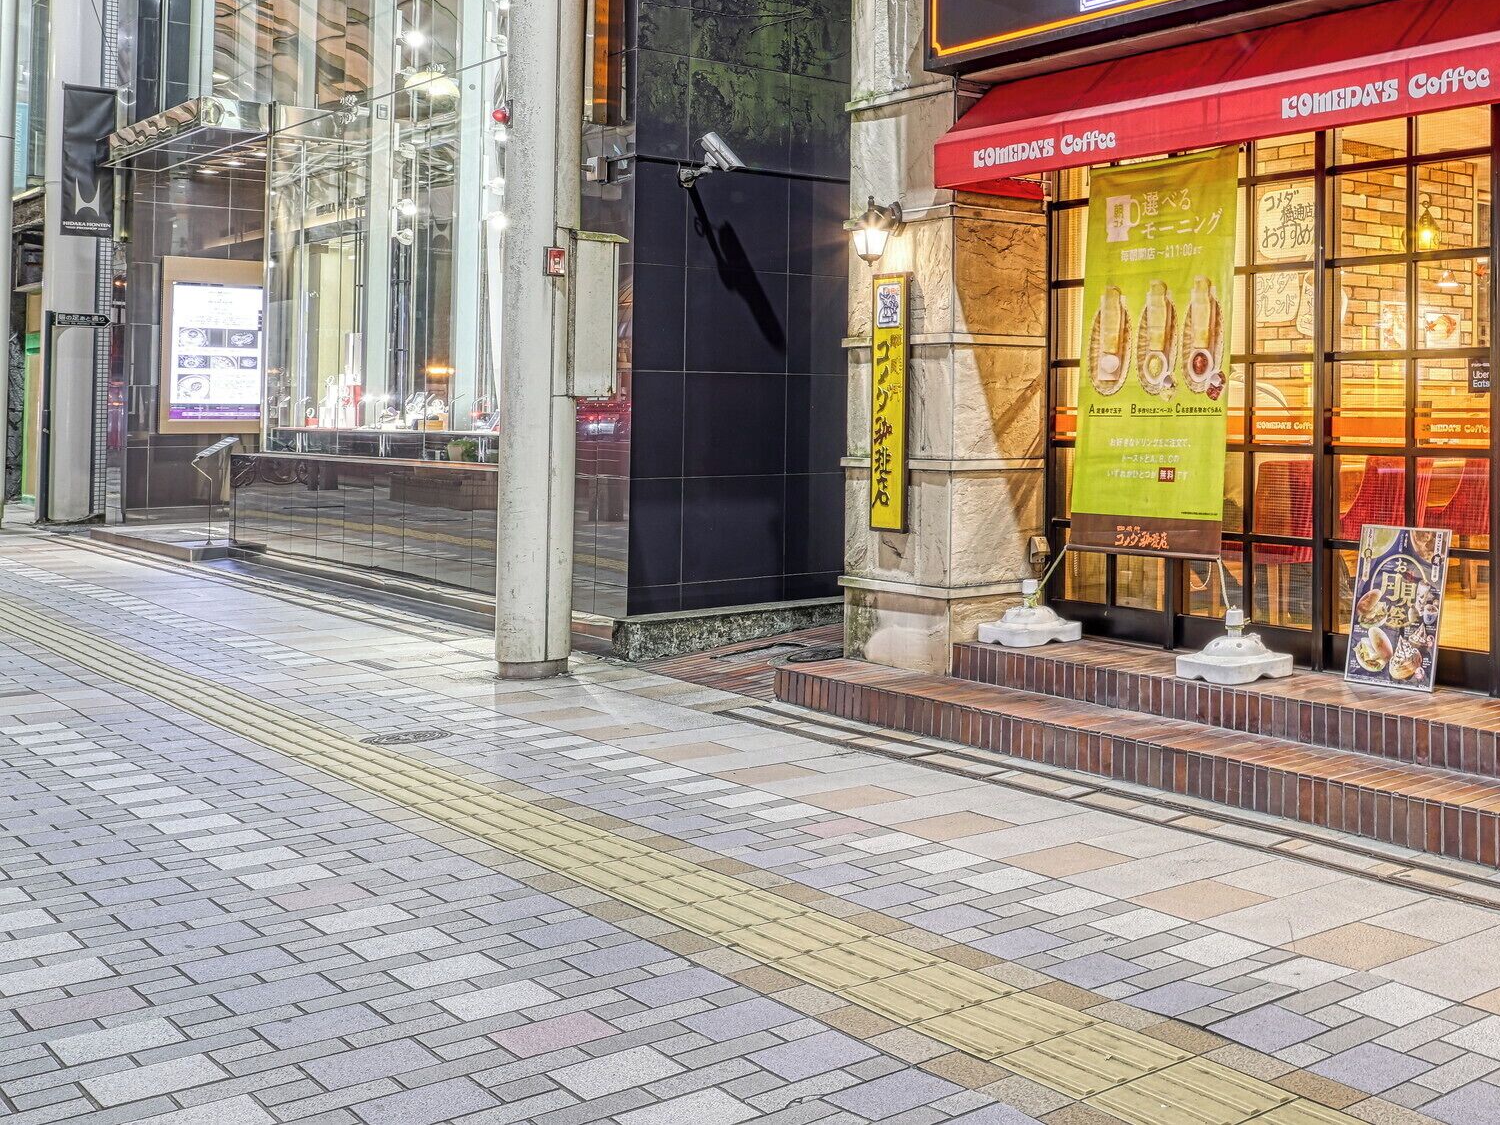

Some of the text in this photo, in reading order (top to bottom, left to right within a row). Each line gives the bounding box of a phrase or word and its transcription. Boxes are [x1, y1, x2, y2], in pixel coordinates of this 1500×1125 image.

[1281, 66, 1491, 120] KOMEDA'S Coffee
[973, 130, 1116, 169] KOMEDA'S Coffee
[1142, 188, 1191, 216] 選べる
[1264, 189, 1299, 212] コメダ
[1141, 208, 1224, 239] モーニング
[1472, 371, 1490, 380] Uber
[1472, 379, 1490, 388] Eats
